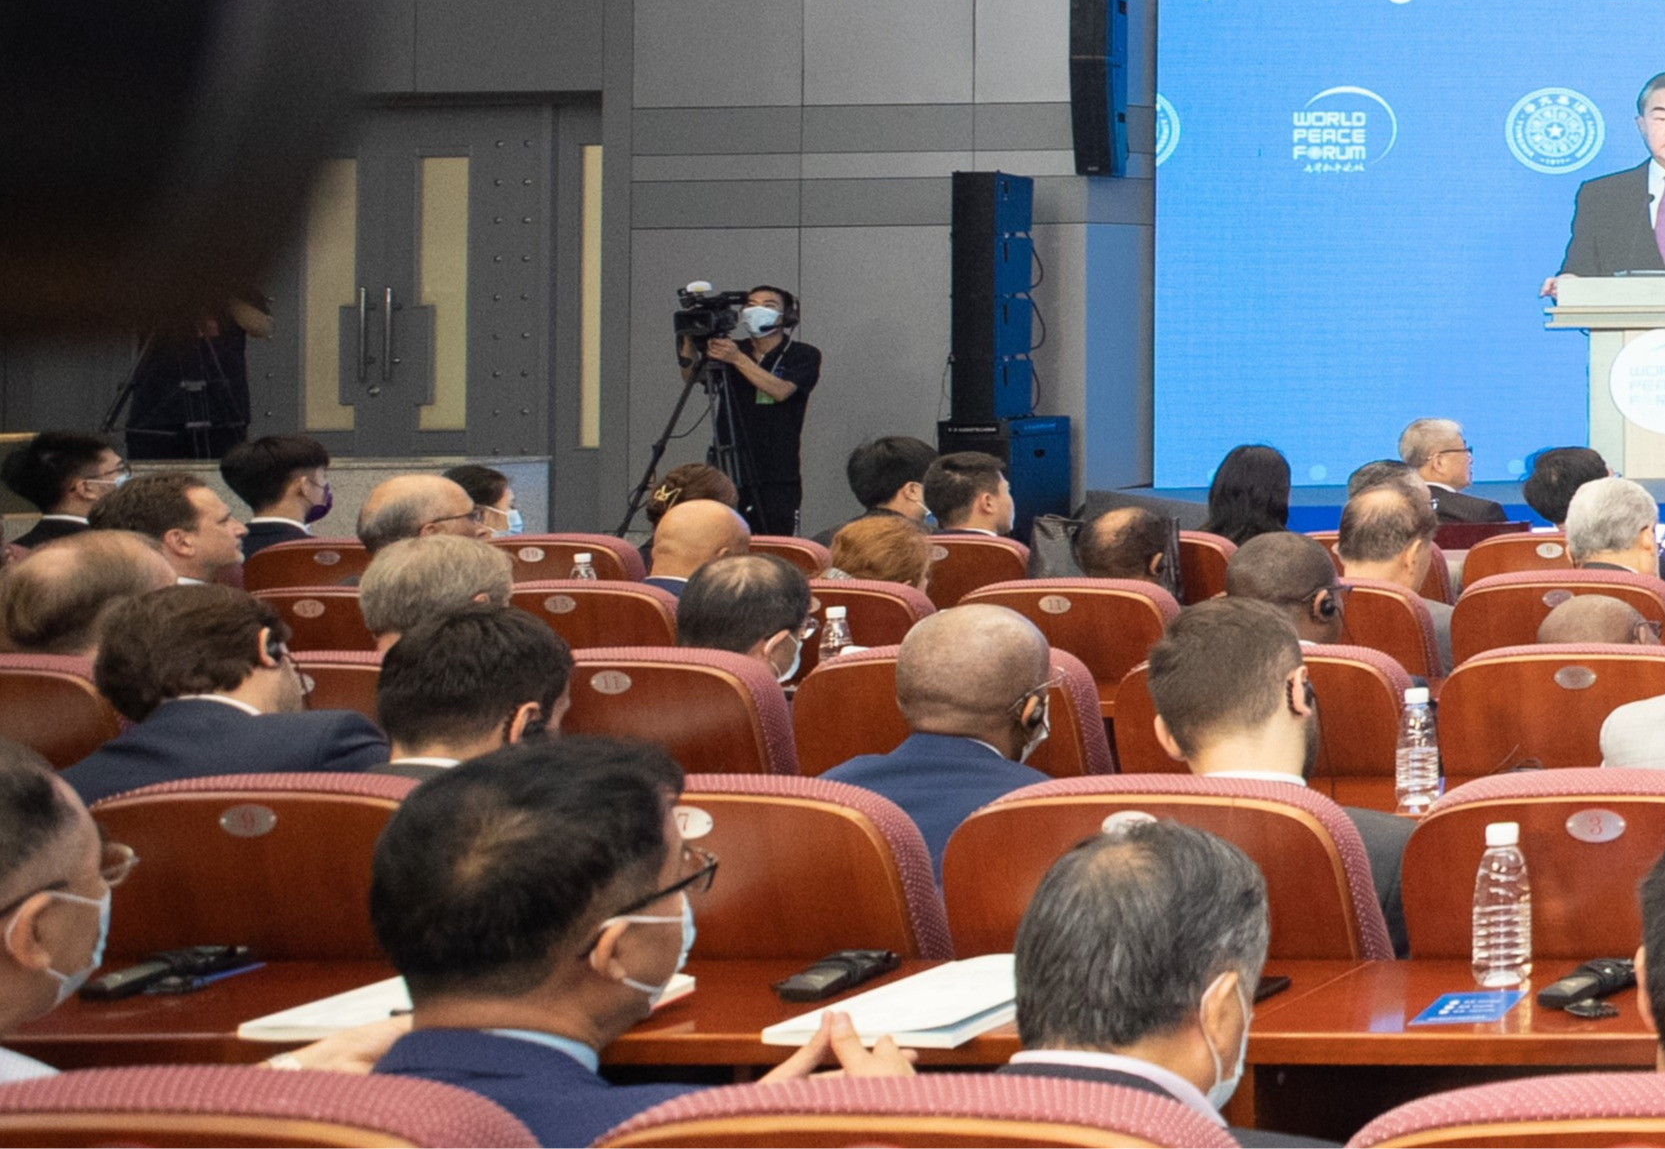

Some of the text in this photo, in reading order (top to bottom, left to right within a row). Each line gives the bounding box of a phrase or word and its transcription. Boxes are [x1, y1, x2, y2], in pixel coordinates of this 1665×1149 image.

[1292, 111, 1367, 127] WORLD
[1292, 128, 1366, 144] PEACE
[1048, 599, 1062, 611] 11
[603, 675, 619, 690] 11
[677, 811, 689, 832] 7
[1587, 815, 1603, 835] 3
